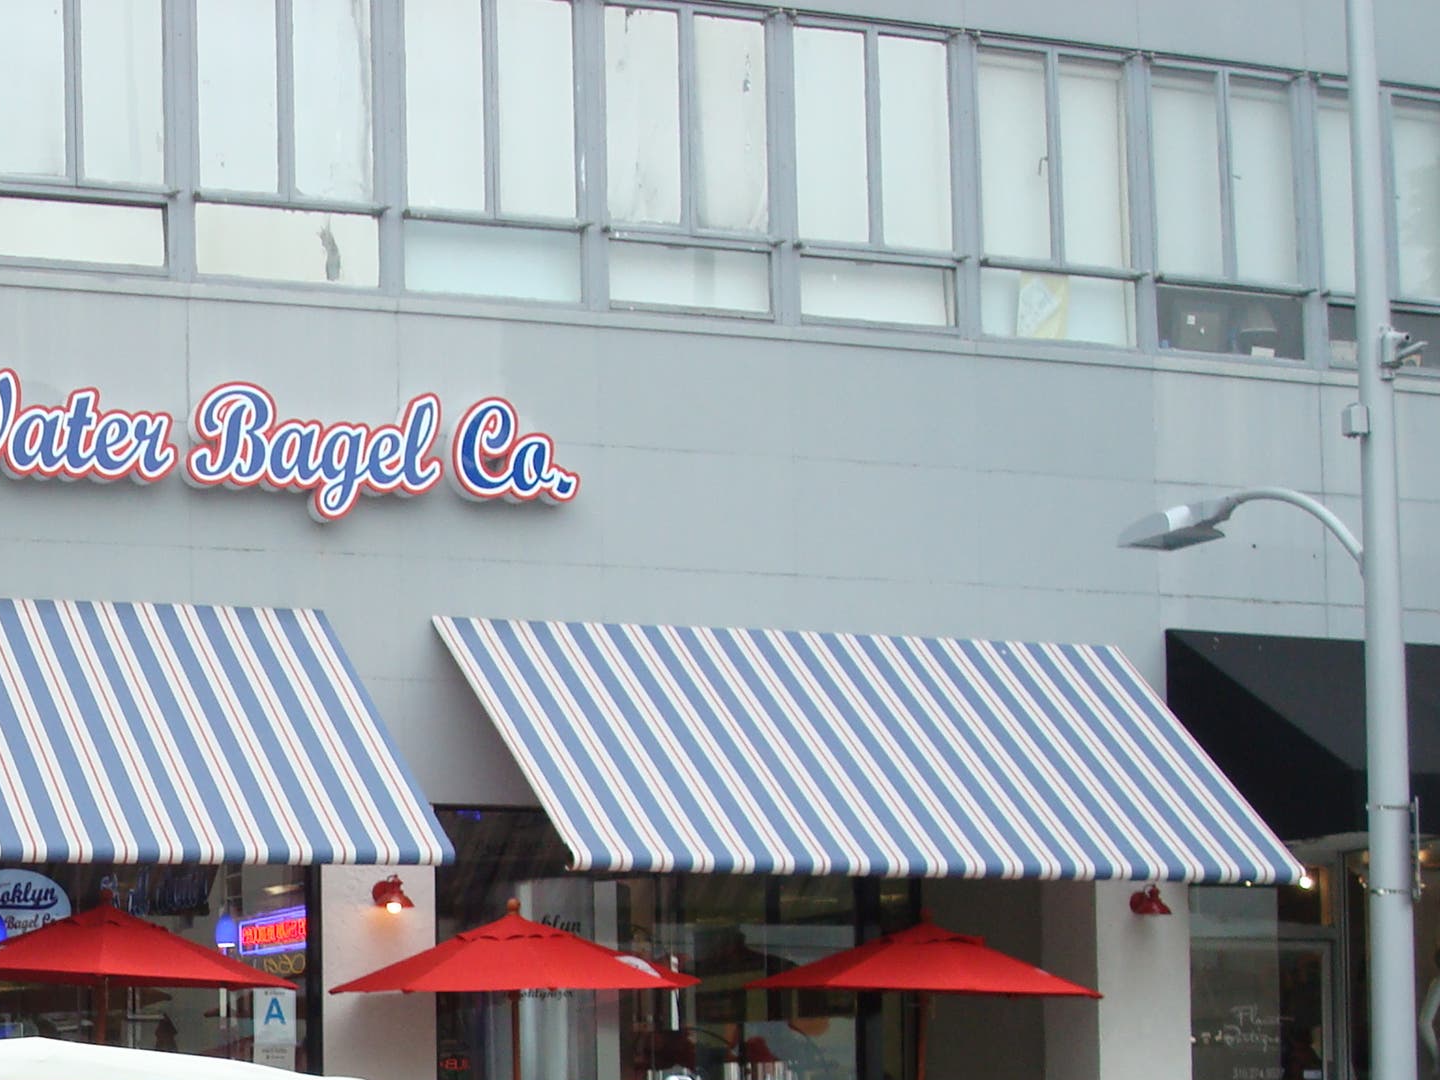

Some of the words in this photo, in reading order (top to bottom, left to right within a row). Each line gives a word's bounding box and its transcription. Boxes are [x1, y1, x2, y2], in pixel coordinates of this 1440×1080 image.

[186, 381, 440, 521] Bagel
[451, 397, 579, 502] Co.
[5, 913, 39, 933] Bagel
[264, 998, 286, 1025] A
